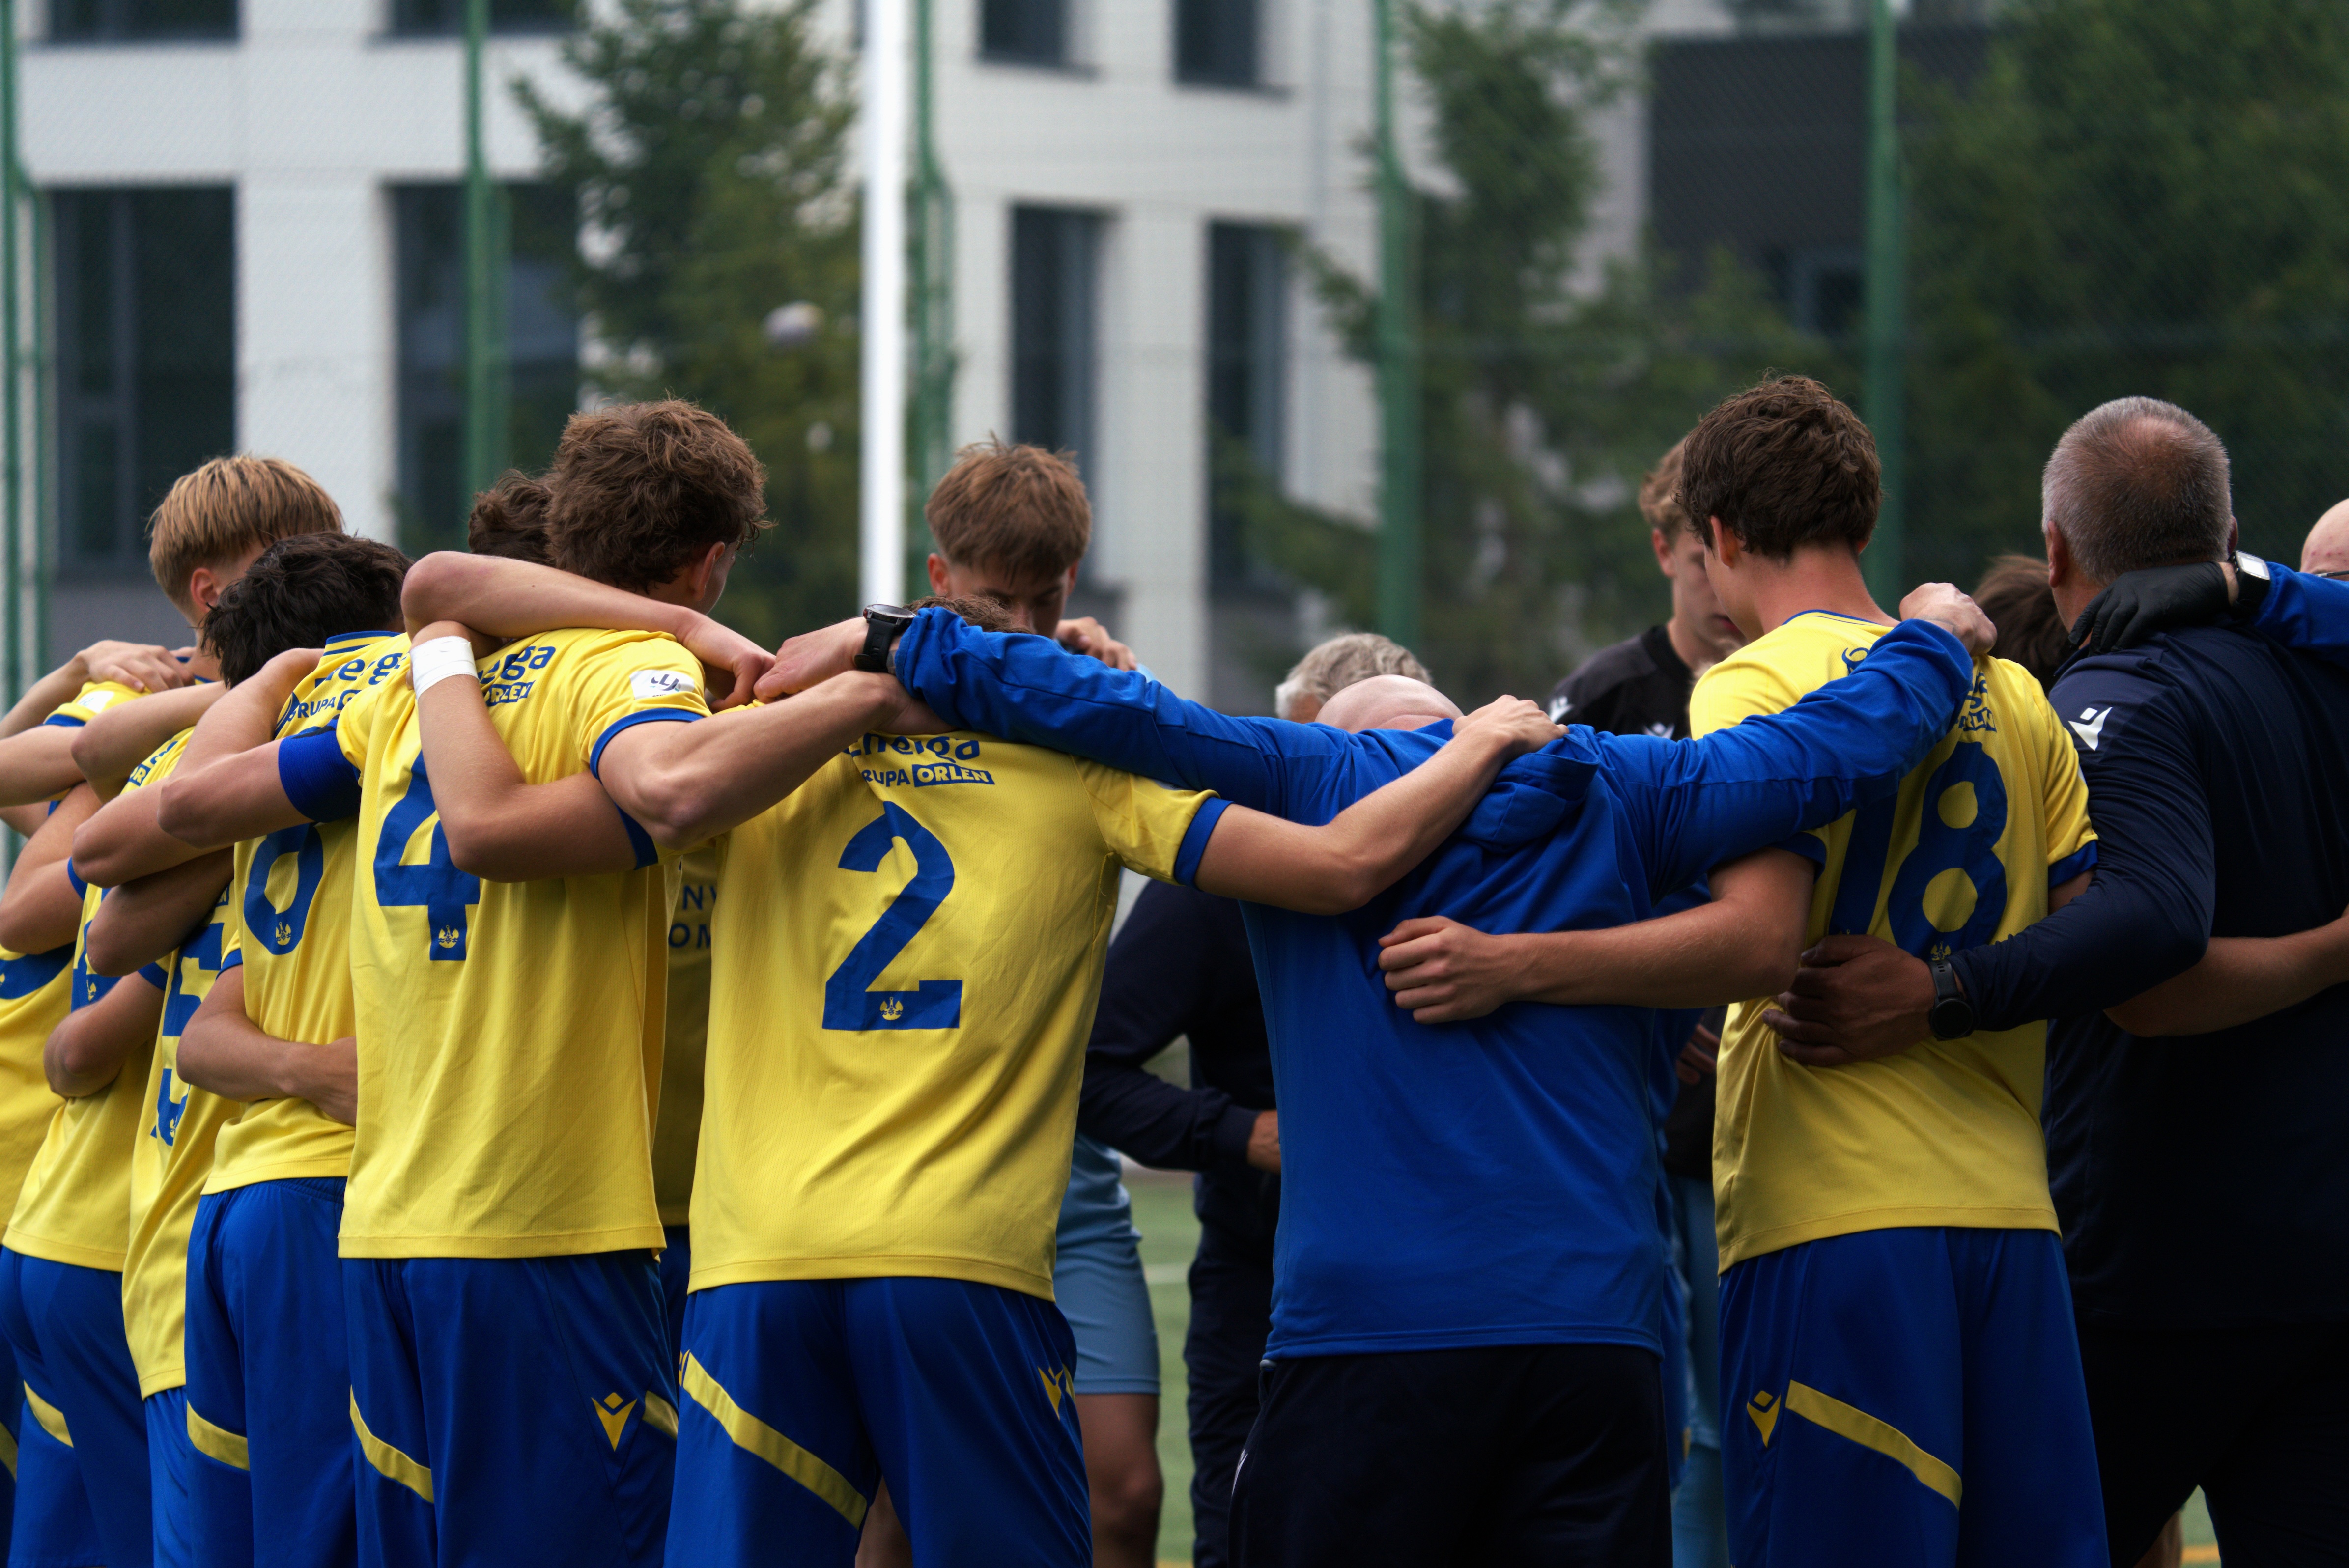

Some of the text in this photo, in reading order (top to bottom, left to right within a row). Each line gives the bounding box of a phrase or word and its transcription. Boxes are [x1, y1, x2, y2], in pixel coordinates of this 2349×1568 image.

[373, 749, 480, 961] 4
[861, 765, 990, 787] RUPA ORLEN
[821, 801, 963, 1031] 2
